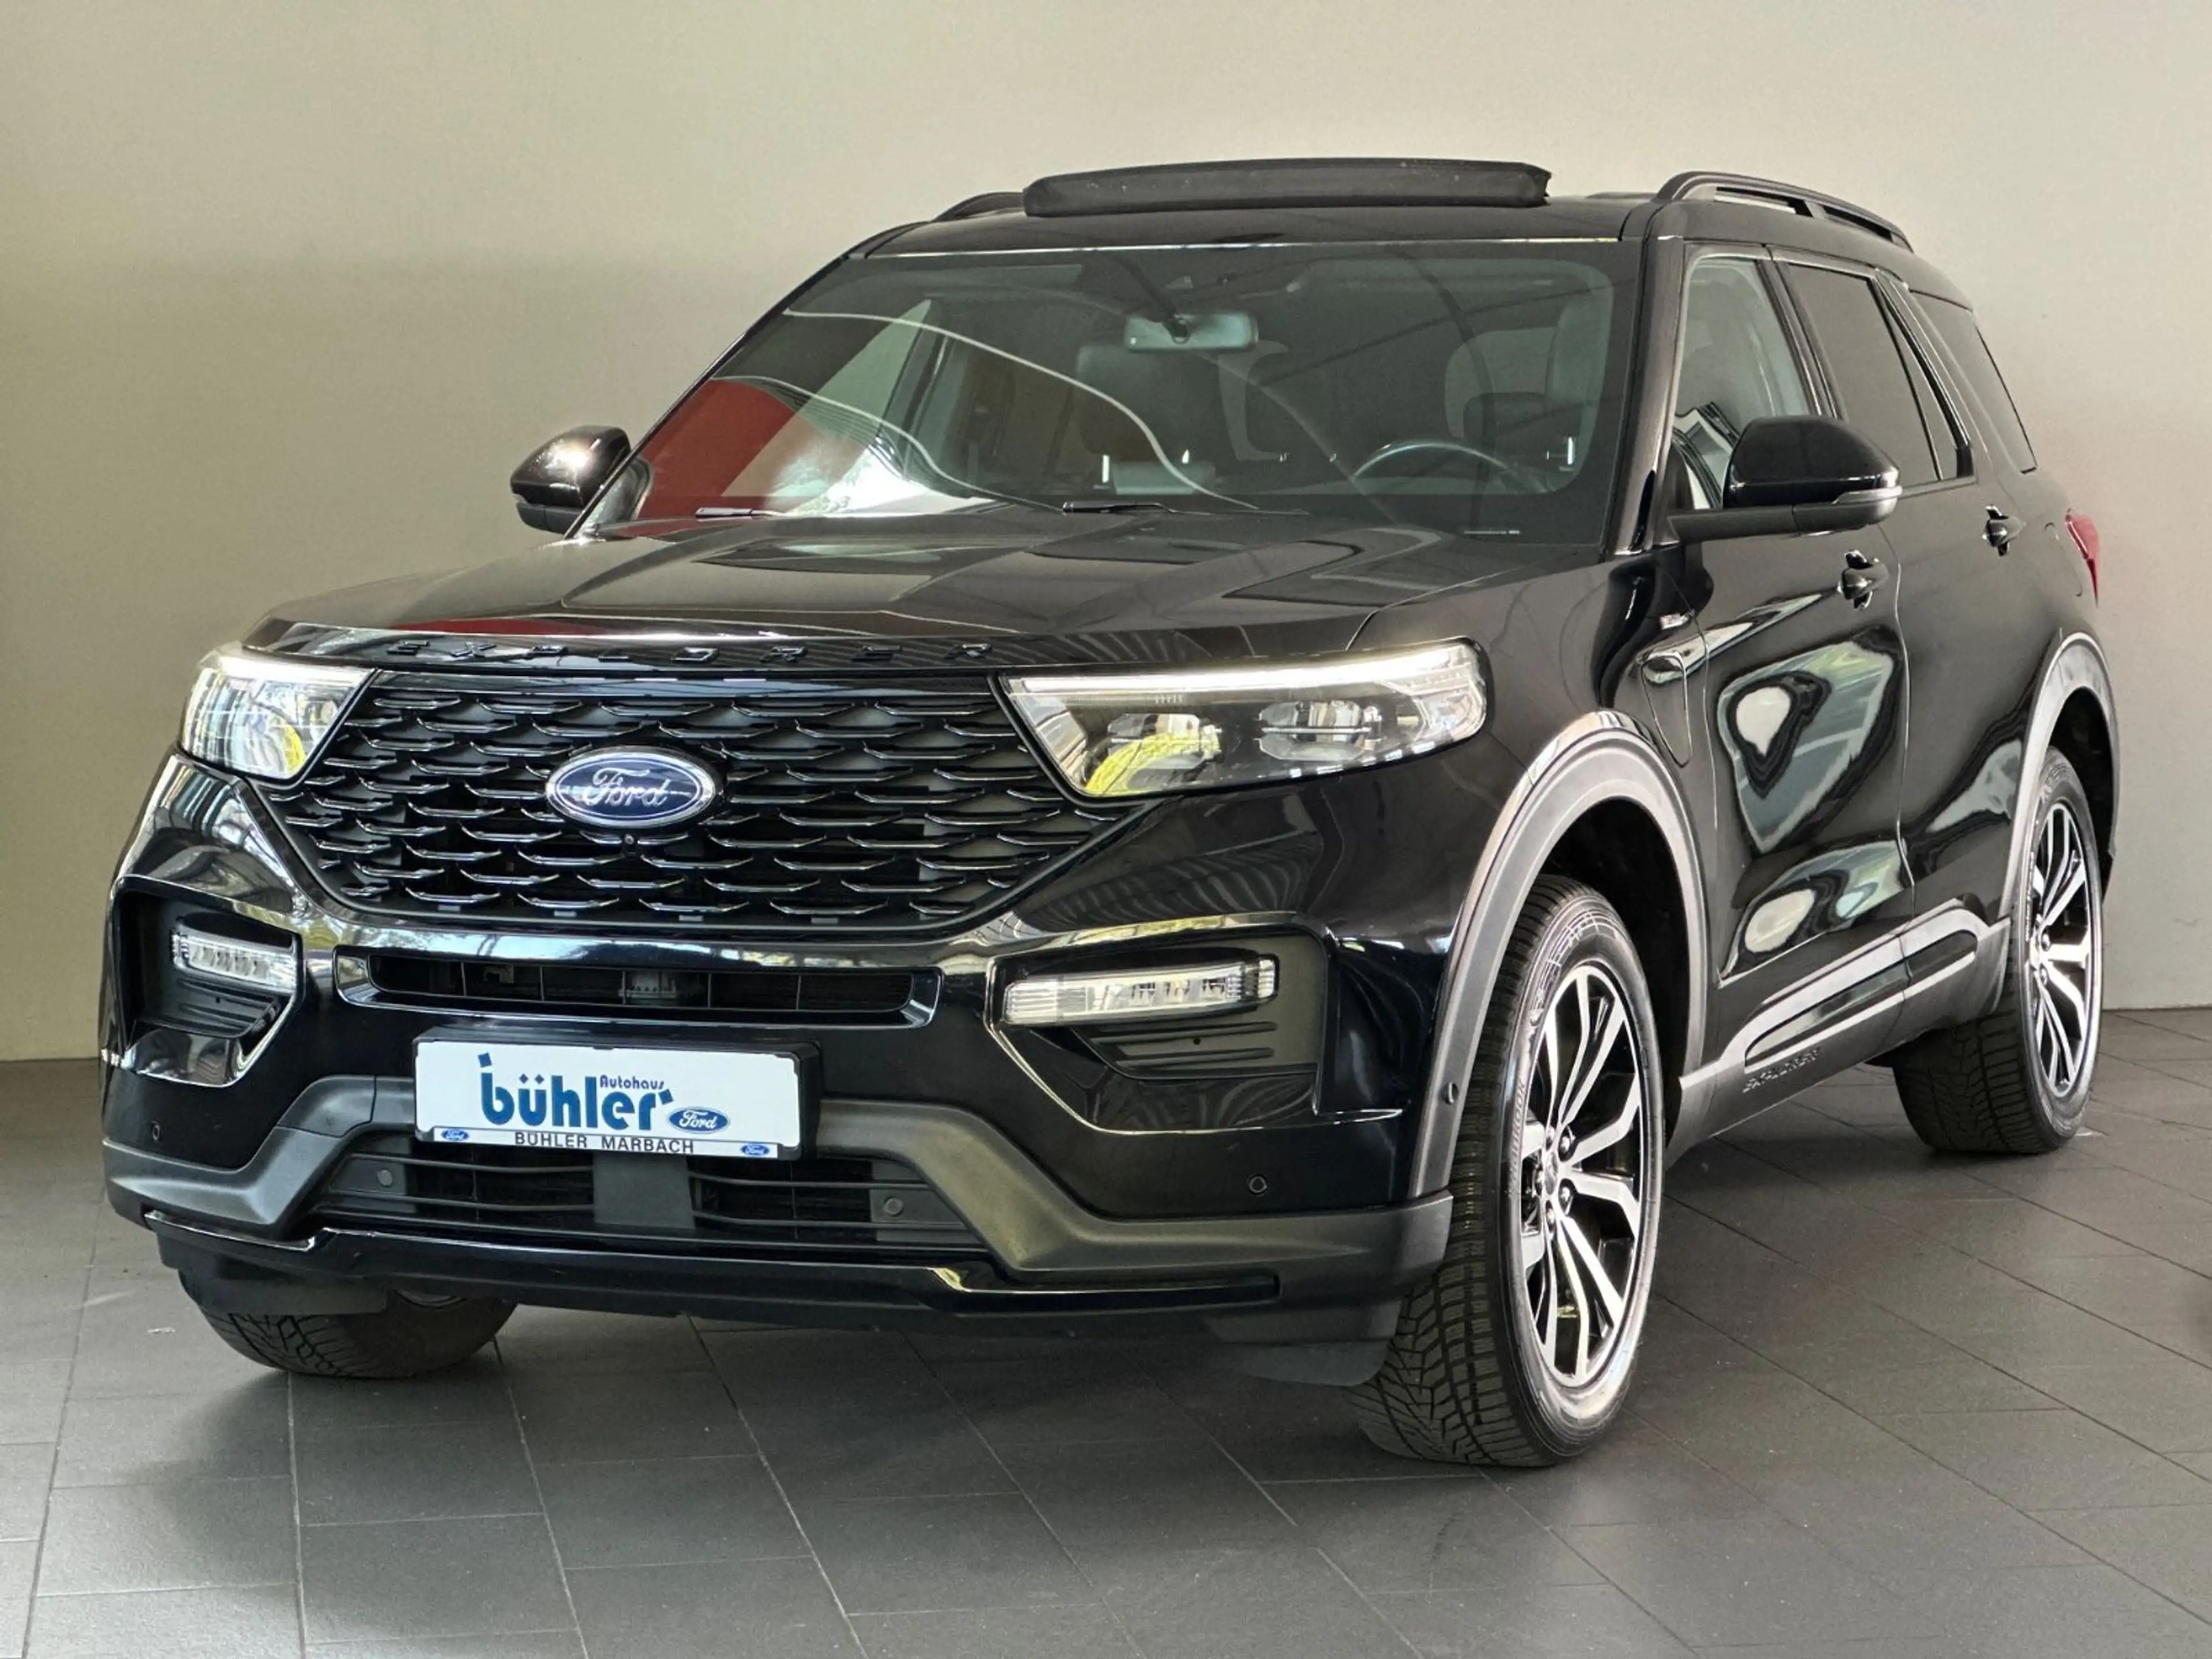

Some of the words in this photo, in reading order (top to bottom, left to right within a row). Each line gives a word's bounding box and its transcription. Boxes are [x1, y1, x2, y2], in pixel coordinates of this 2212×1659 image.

[582, 767, 672, 806] Ford
[600, 1074, 665, 1090] Autohaus
[480, 1072, 657, 1131] bühler
[679, 1109, 718, 1129] Ford
[601, 1137, 694, 1154] MARBACH
